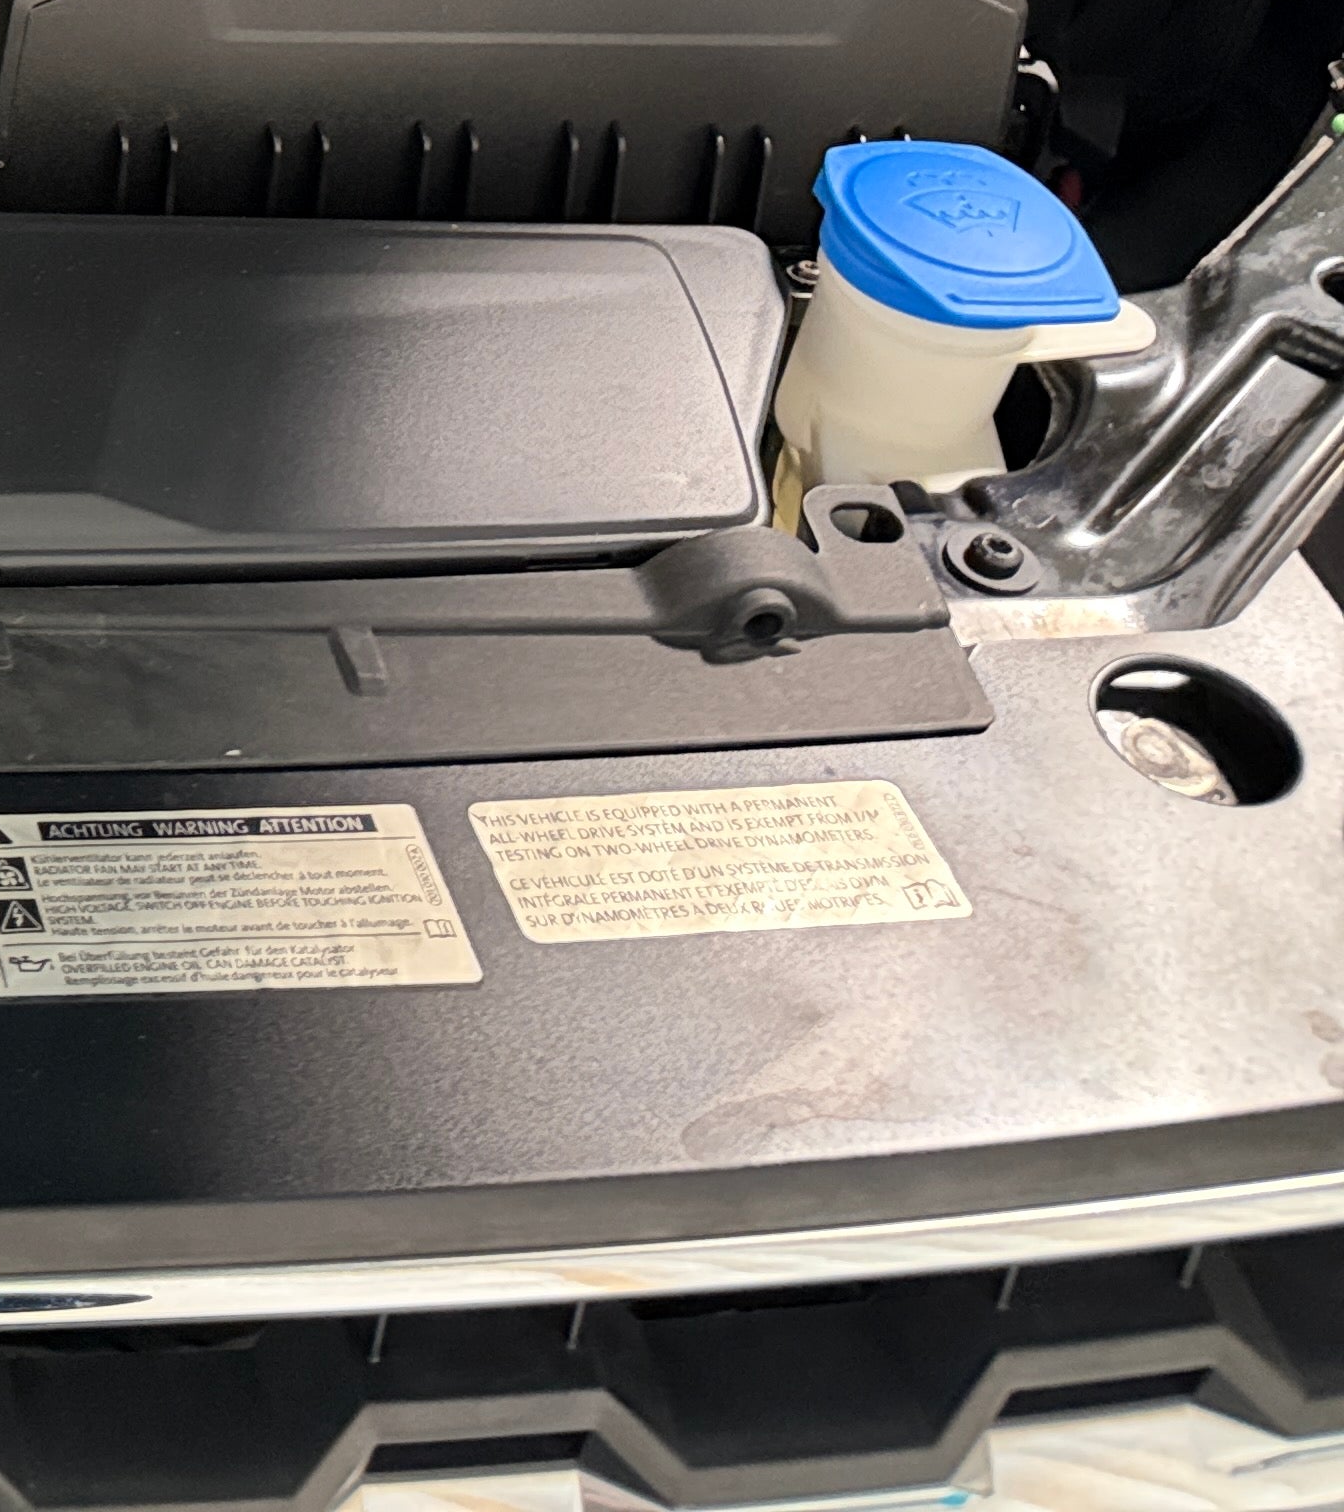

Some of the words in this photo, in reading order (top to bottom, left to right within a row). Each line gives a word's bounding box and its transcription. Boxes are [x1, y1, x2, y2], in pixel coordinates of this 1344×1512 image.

[481, 815, 519, 827] THIS
[516, 811, 585, 826] VEHICLE
[585, 809, 601, 822] IS
[603, 805, 681, 820] EQUIPPED
[682, 799, 727, 815] WITH
[729, 800, 744, 811] A
[745, 795, 838, 812] PERMANENT
[48, 822, 143, 838] ACHTUNG
[151, 818, 249, 836] WARNING
[258, 815, 364, 834] ATTENTION
[488, 830, 578, 846] ALL-WHEEL
[579, 826, 626, 840] DRIVE
[626, 822, 689, 838] SYSTEM
[690, 819, 725, 834] AND
[726, 819, 744, 831] IS
[745, 814, 804, 830] EXEMPT
[807, 810, 854, 825] FROM
[495, 846, 563, 862] TESTING
[566, 844, 592, 858] ON
[593, 840, 696, 857] TWO-WHEEL
[694, 836, 743, 850] DRIVE
[509, 878, 529, 891] CE
[528, 872, 607, 890] VÉHICULE
[611, 871, 634, 885] EST
[637, 867, 681, 883] DOTÉ
[681, 864, 725, 879] D'UN
[794, 860, 815, 873] DE
[815, 853, 931, 872] TRANSMISSION
[517, 892, 602, 909] INTÉGRALE
[602, 886, 693, 904] PERMANENT
[696, 884, 713, 898] ET
[525, 912, 561, 927] SUR
[705, 900, 750, 915] DEUX
